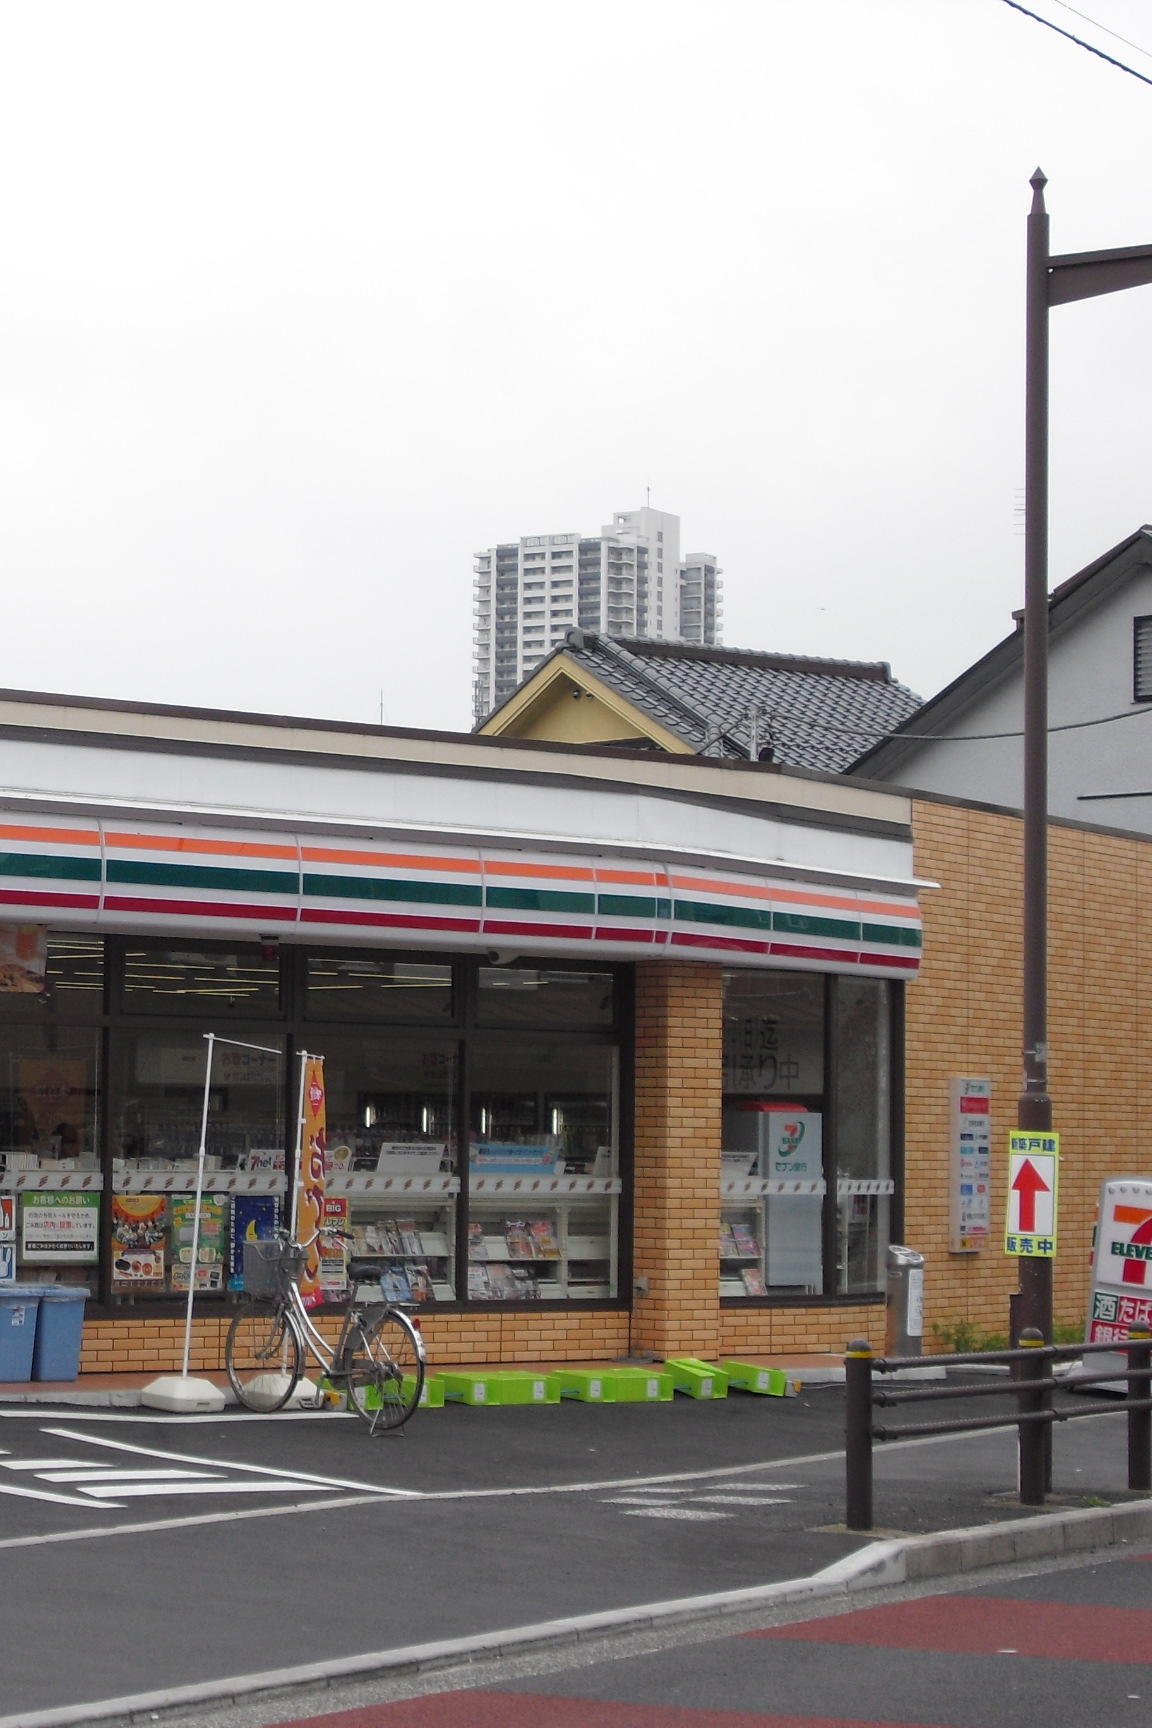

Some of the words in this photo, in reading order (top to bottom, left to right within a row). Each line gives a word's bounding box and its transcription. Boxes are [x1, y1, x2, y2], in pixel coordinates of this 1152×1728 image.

[325, 1204, 342, 1213] BIG
[1006, 1236, 1054, 1255] 販売中
[1094, 1294, 1117, 1322] 酒
